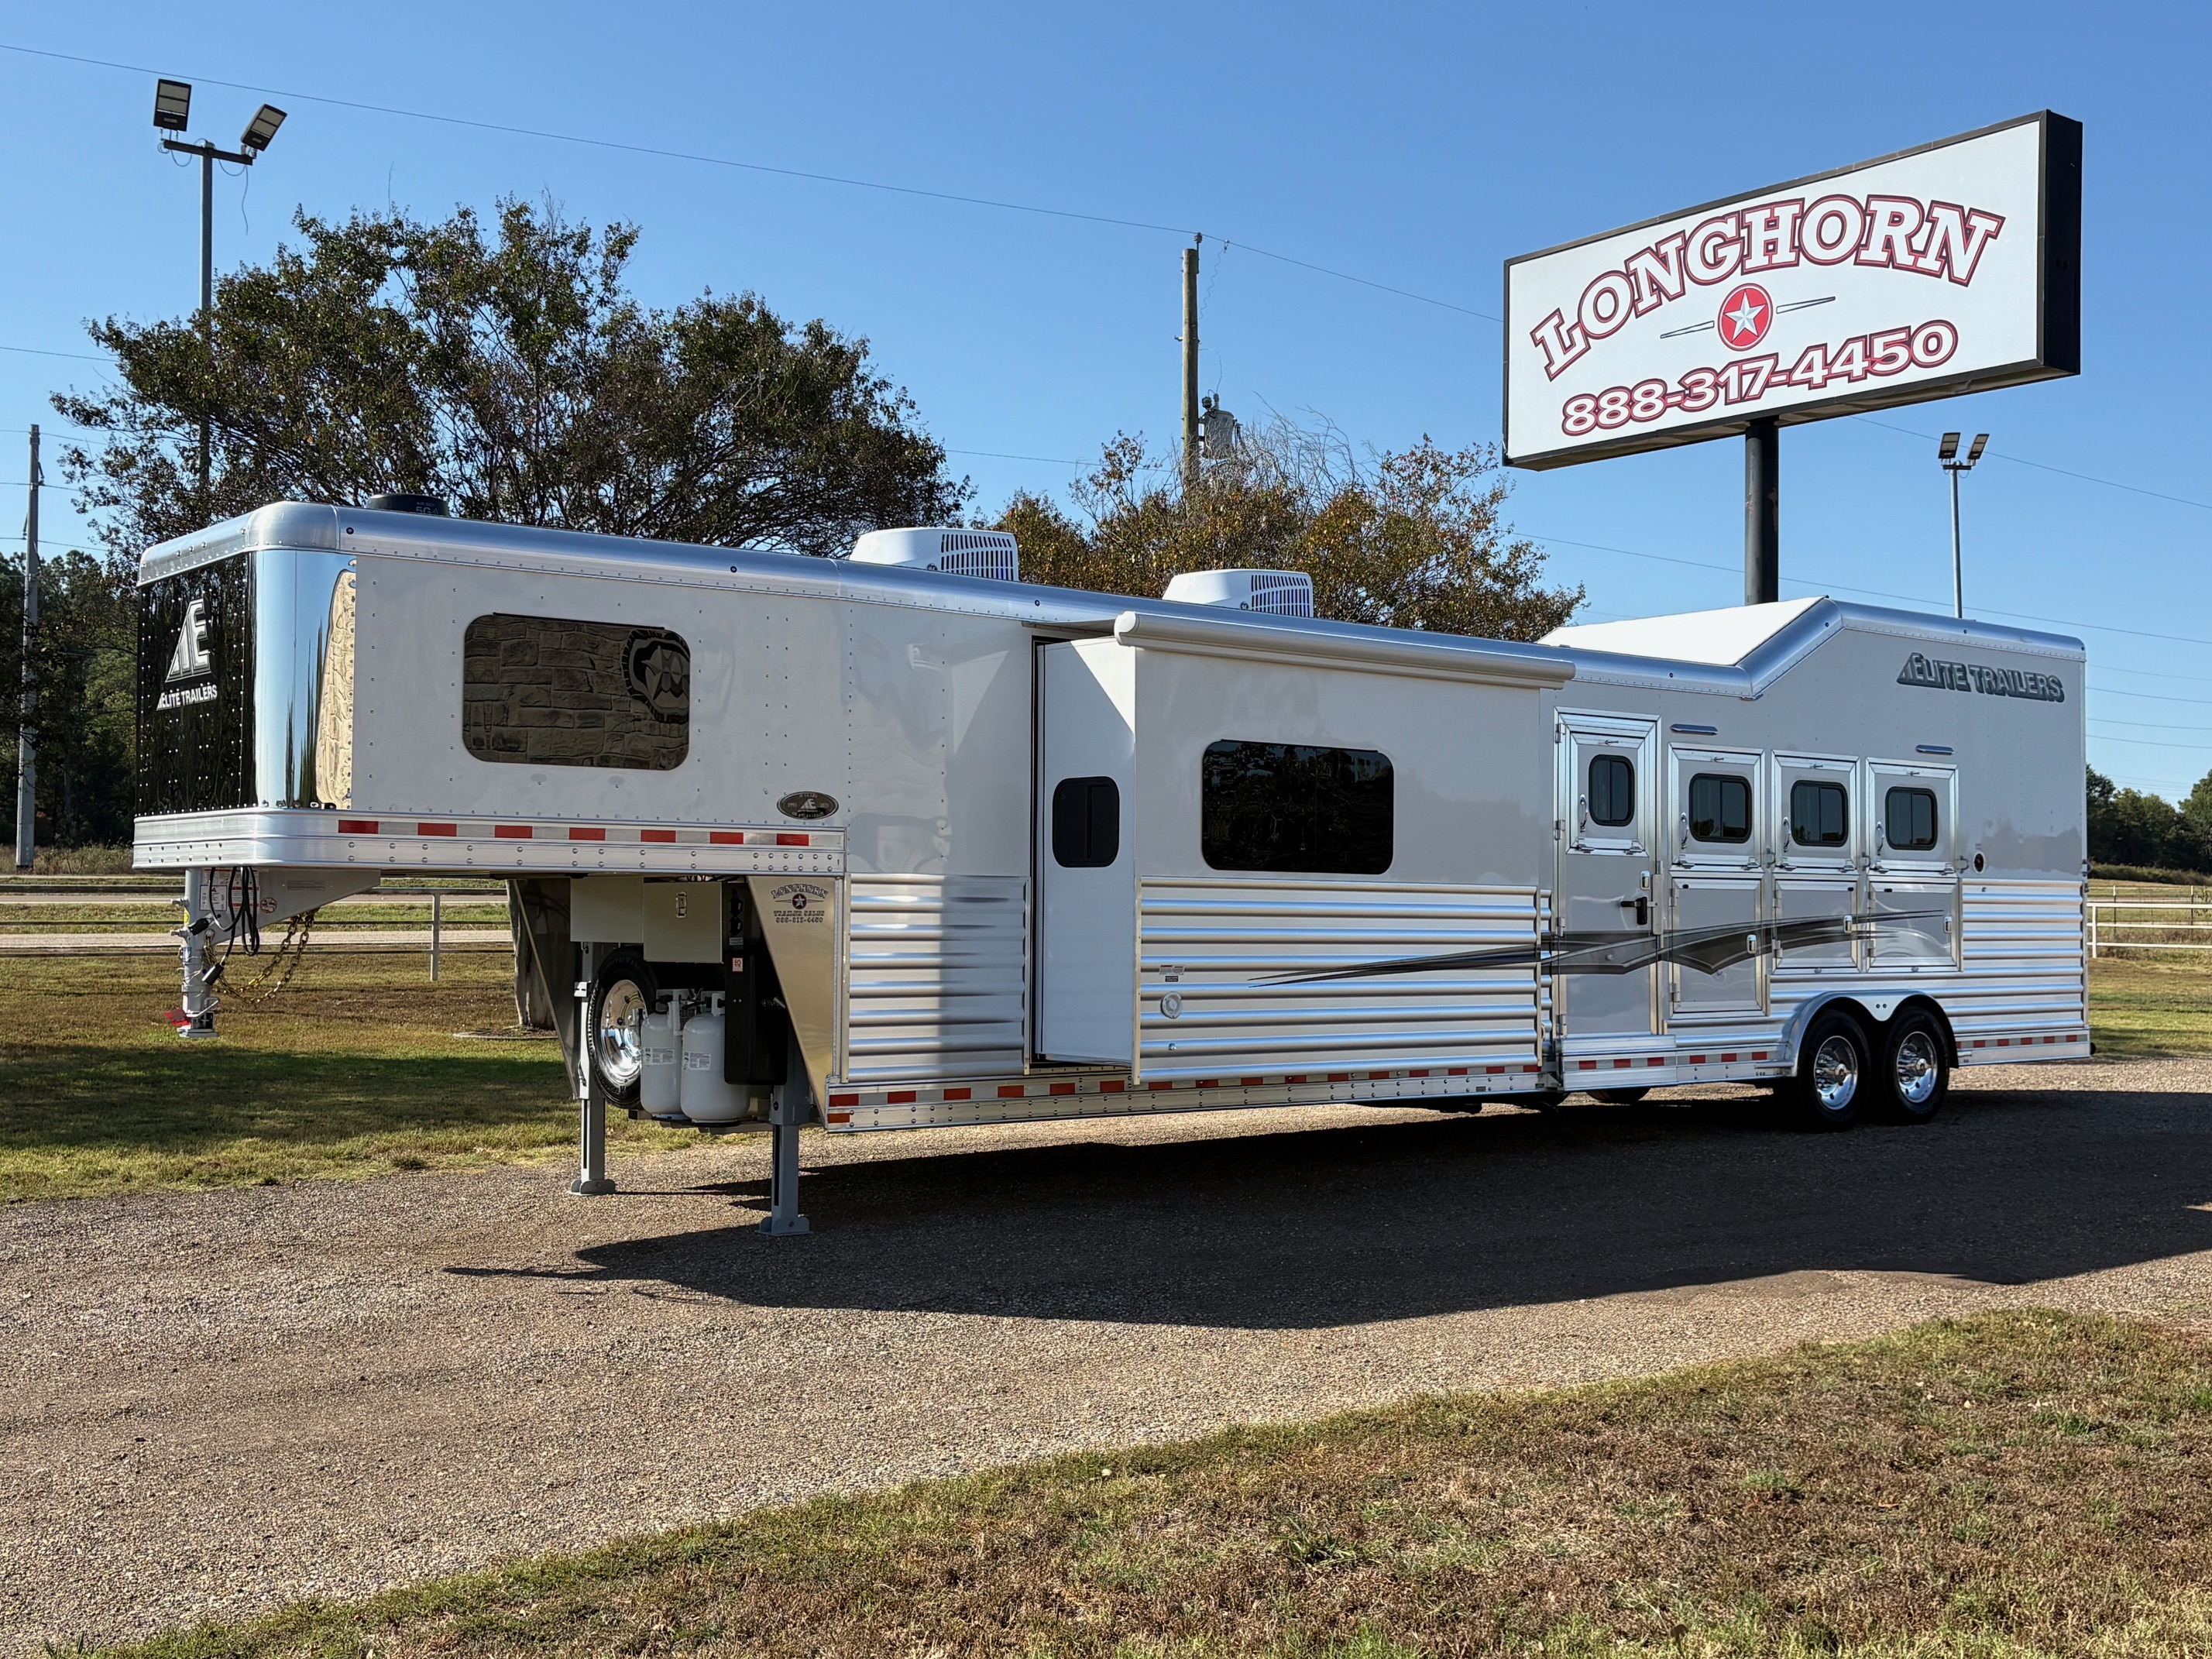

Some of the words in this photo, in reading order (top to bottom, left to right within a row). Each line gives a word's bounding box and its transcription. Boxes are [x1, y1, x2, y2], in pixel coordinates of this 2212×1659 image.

[1530, 194, 2006, 382] LONGHORN
[1561, 320, 1958, 436] 888-317-4450
[156, 691, 181, 711] ELITE
[181, 684, 218, 706] TRAILERS
[1896, 652, 1971, 692] ELITE
[1968, 665, 2065, 702] TRAILERS
[771, 883, 828, 899] LONGHORN
